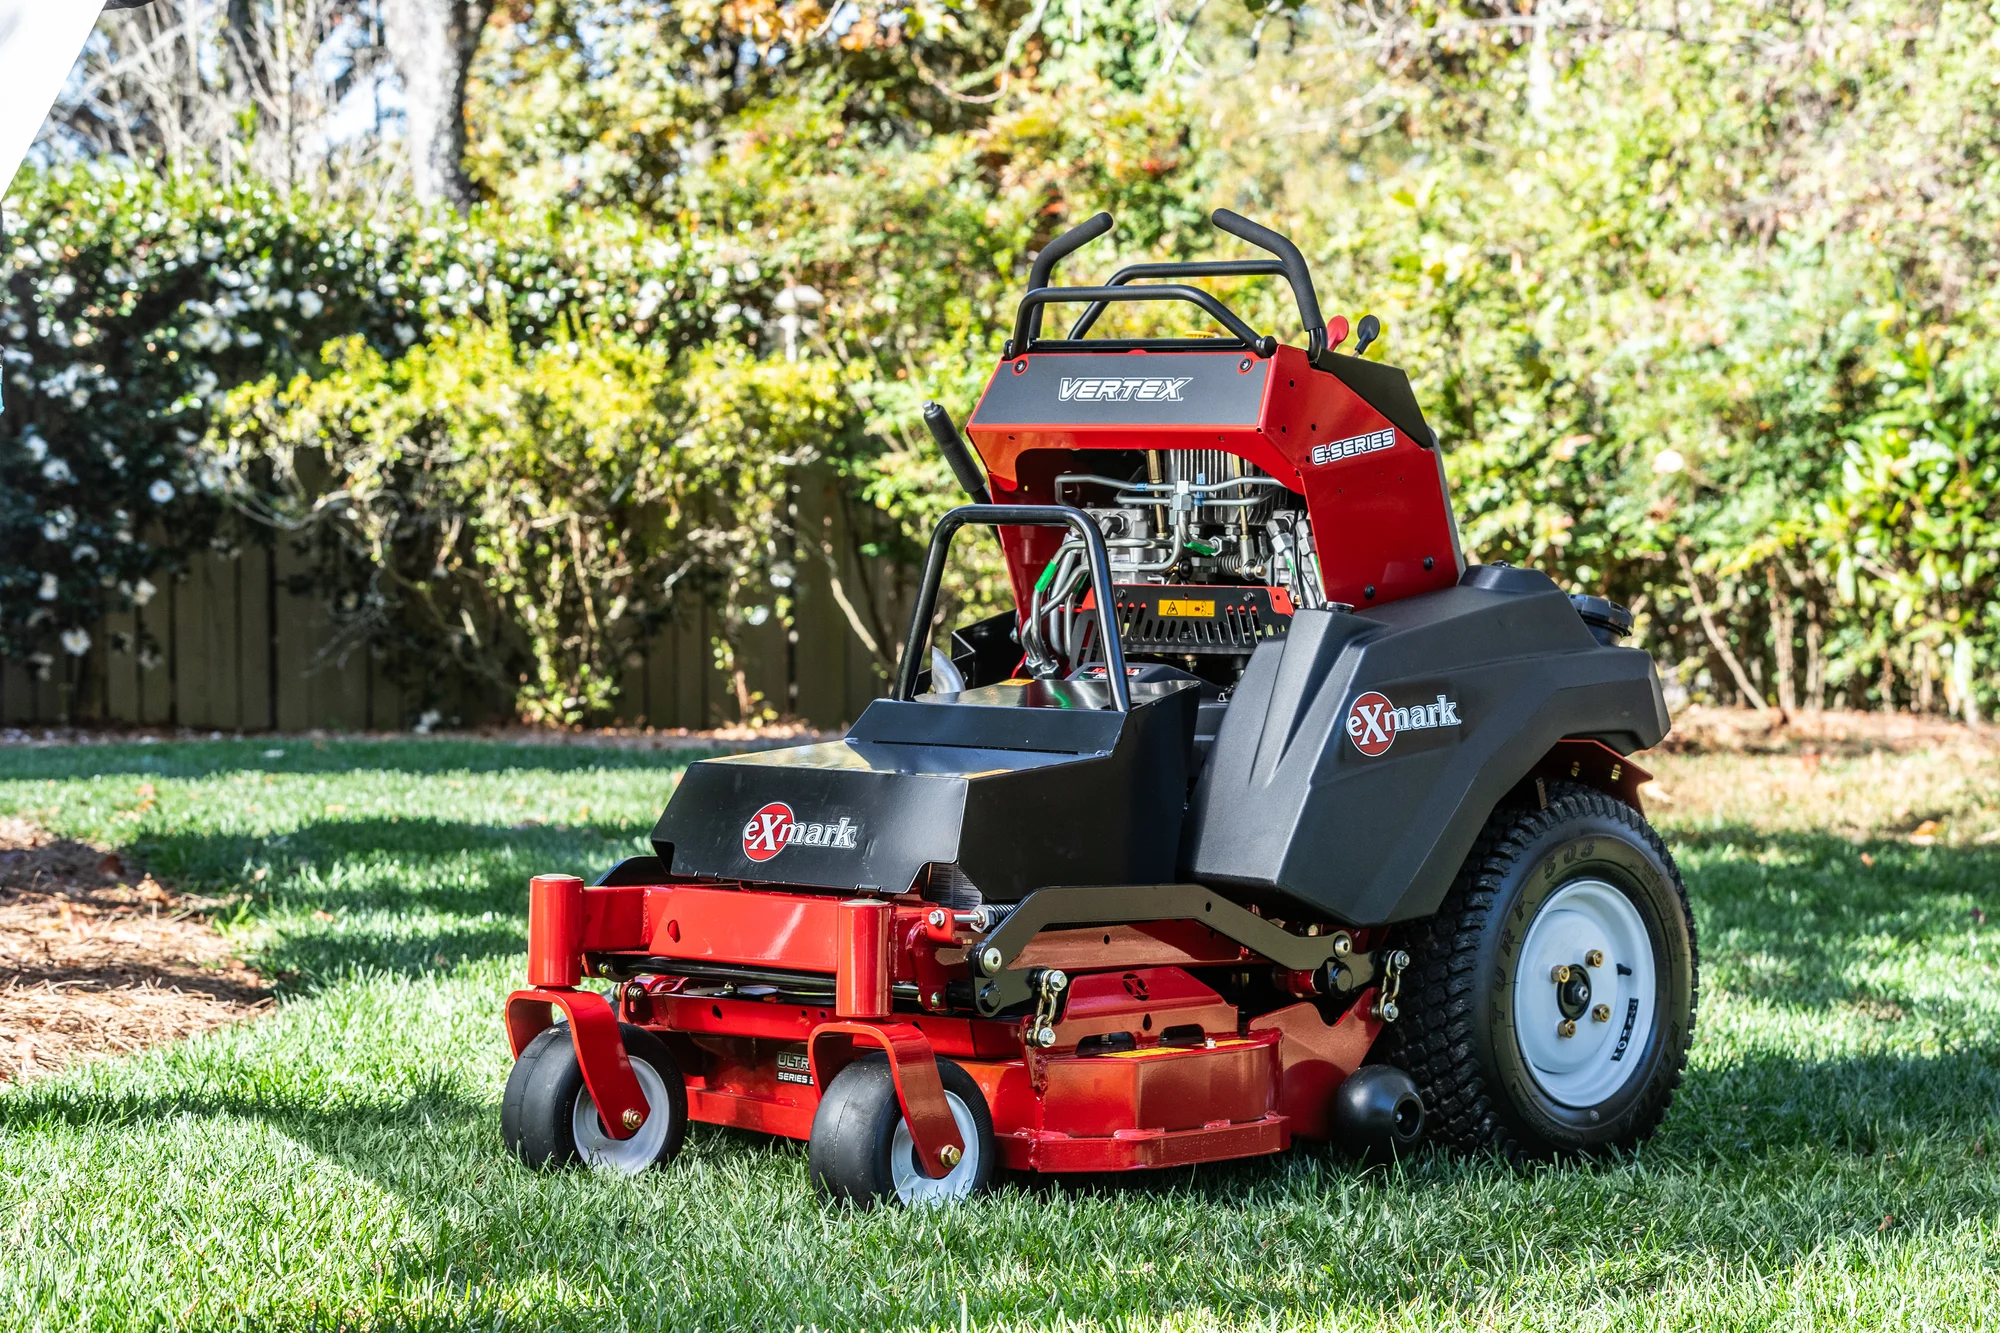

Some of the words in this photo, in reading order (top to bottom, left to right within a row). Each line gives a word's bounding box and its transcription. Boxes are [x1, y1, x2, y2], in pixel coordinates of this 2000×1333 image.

[1059, 377, 1193, 401] VERTEX
[1312, 428, 1395, 465] E-SERIES
[1347, 695, 1459, 746] eXmark
[744, 812, 857, 851] eXmark
[777, 1052, 811, 1072] ULTR
[778, 1072, 808, 1084] SERIES
